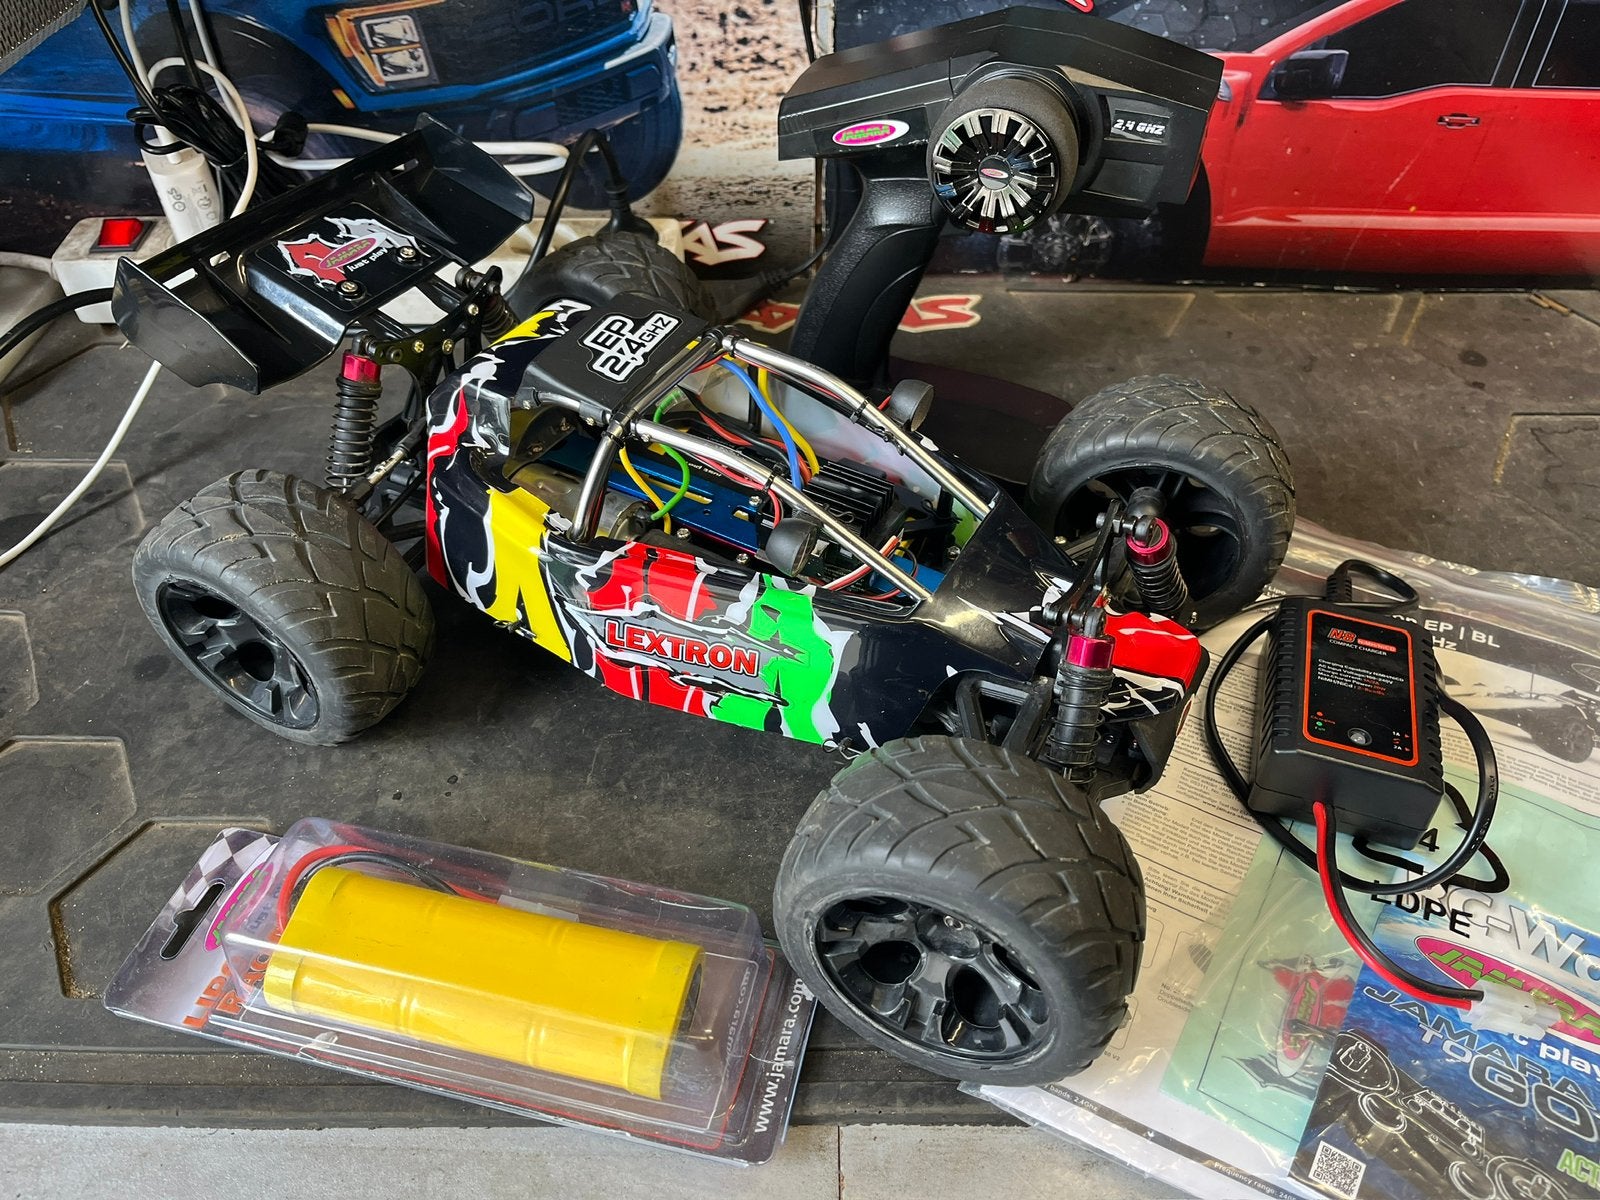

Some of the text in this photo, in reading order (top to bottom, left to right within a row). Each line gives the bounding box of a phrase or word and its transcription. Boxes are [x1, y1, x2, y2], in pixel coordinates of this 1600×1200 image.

[347, 258, 370, 273] just
[590, 318, 629, 351] EP
[605, 619, 759, 676] LEXTRON
[1424, 619, 1454, 634] EP
[1472, 629, 1500, 649] BL
[1432, 636, 1458, 651] Hz
[754, 977, 804, 1134] www.jamara.com
[1363, 986, 1597, 1112] JAMARA
[1419, 1022, 1476, 1064] TO
[1469, 1053, 1600, 1143] GO
